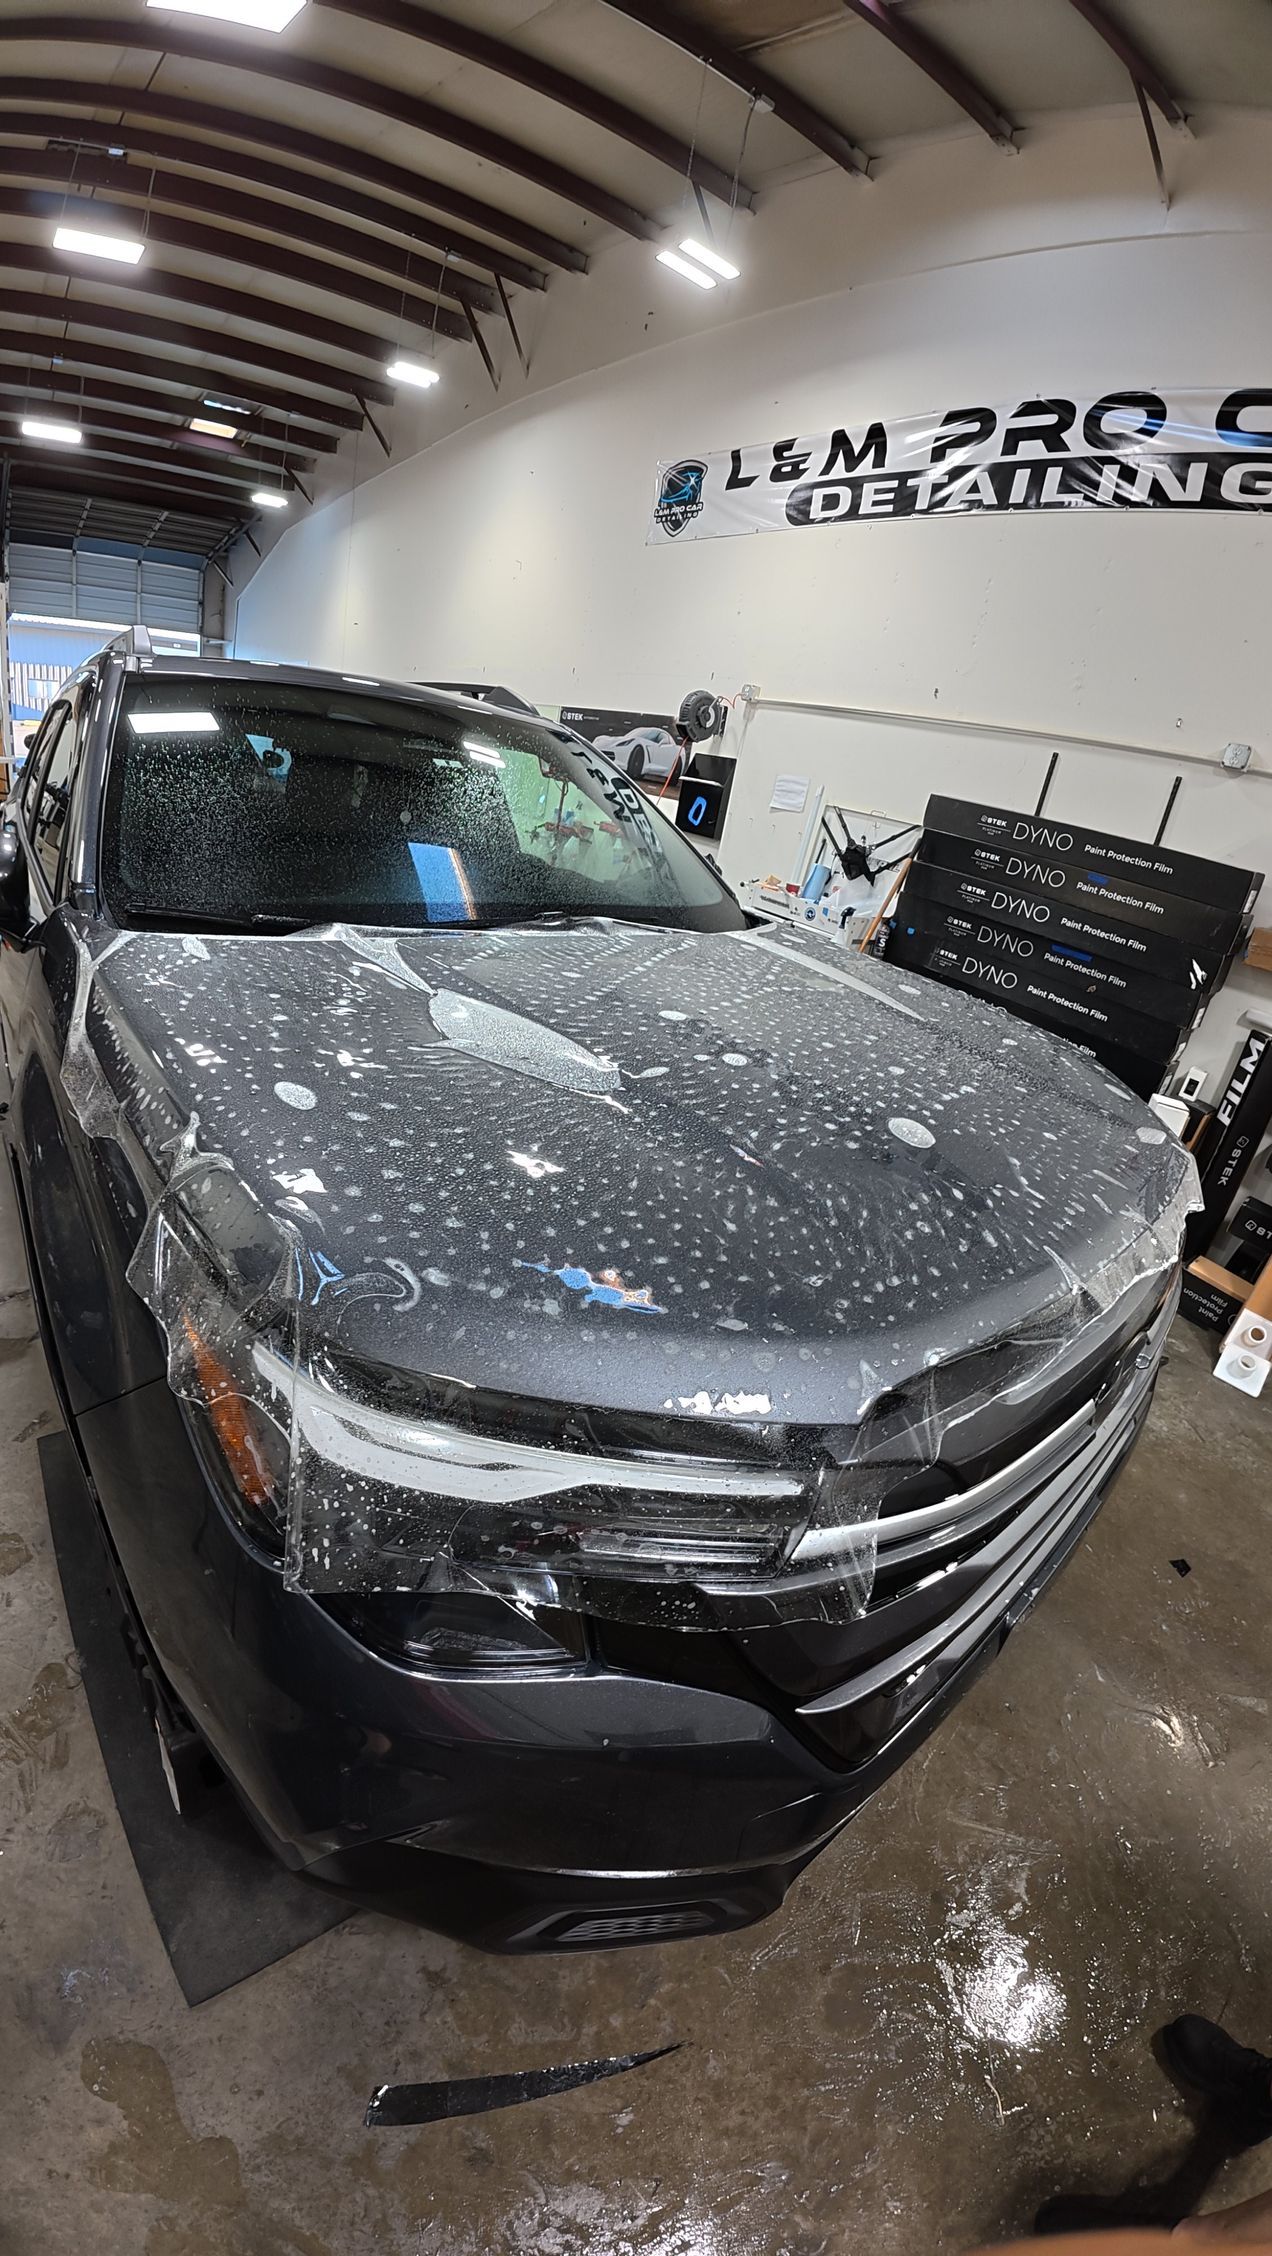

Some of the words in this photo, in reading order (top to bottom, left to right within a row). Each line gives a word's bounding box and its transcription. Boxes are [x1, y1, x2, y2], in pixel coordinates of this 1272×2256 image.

[724, 421, 888, 491] L&M
[930, 390, 1168, 464] PRO
[808, 461, 1272, 520] DETAILING
[670, 505, 686, 514] PRO
[686, 502, 703, 512] CAR
[567, 712, 584, 721] STEK
[1013, 822, 1073, 851] DYNO
[1005, 857, 1065, 887] DYNO
[1084, 844, 1106, 856] Paint
[1107, 850, 1152, 869] Protection
[1153, 862, 1173, 875] Film
[991, 891, 1050, 922] DYNO
[1076, 881, 1098, 894] Paint
[1098, 888, 1143, 908] Protection
[1144, 901, 1164, 914] Film
[977, 925, 1034, 957] DYNO
[1060, 917, 1082, 931] Paint
[1082, 924, 1126, 945] Protection
[1127, 939, 1147, 952] Film
[962, 956, 1018, 989] DYNO
[1044, 952, 1064, 966] Paint
[1064, 959, 1107, 982] Protection
[1108, 975, 1127, 988] Film
[1027, 984, 1048, 999] Paint
[1047, 992, 1089, 1015] Protection
[1089, 1009, 1108, 1022] Film
[1216, 1037, 1266, 1127] FILM
[1217, 1148, 1242, 1187] STEK
[1183, 1288, 1224, 1315] Protection
[1198, 1306, 1219, 1322] Paint
[1210, 1294, 1228, 1308] Film
